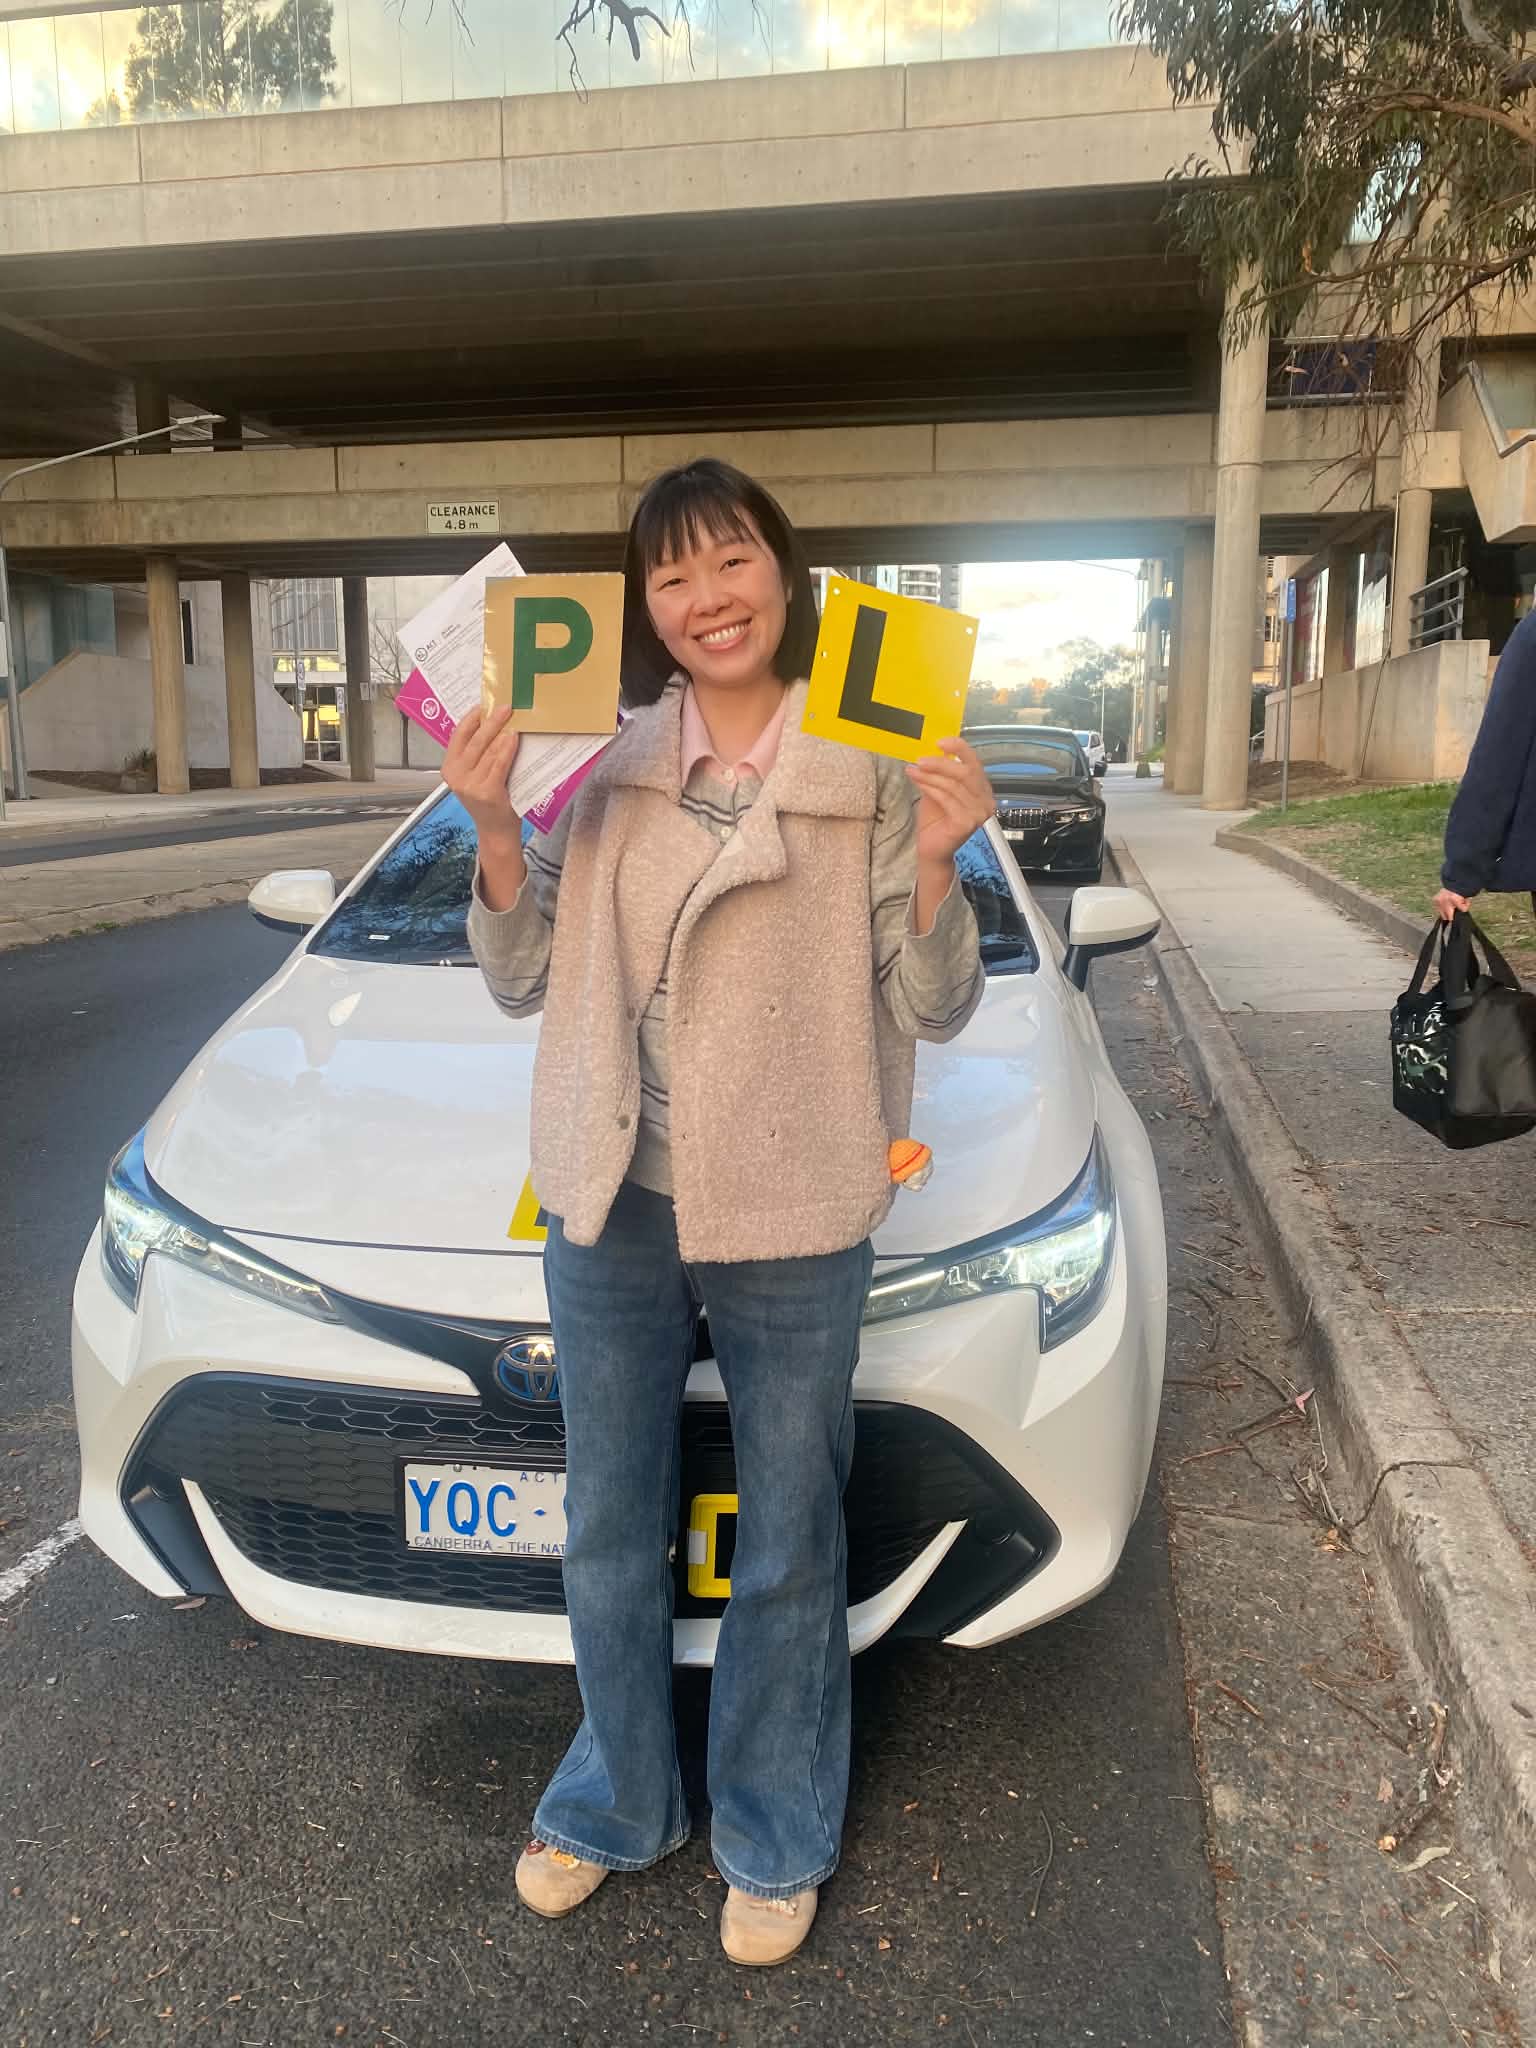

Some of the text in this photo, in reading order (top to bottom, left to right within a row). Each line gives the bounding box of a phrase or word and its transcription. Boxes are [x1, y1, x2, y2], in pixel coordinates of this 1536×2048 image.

[430, 505, 496, 517] CLEARANCE
[444, 520, 466, 530] 4.8
[511, 596, 594, 710] P
[837, 604, 925, 740] L
[414, 1535, 492, 1551] CANBERRA
[508, 1541, 537, 1554] THE
[541, 1543, 567, 1555] NAT
